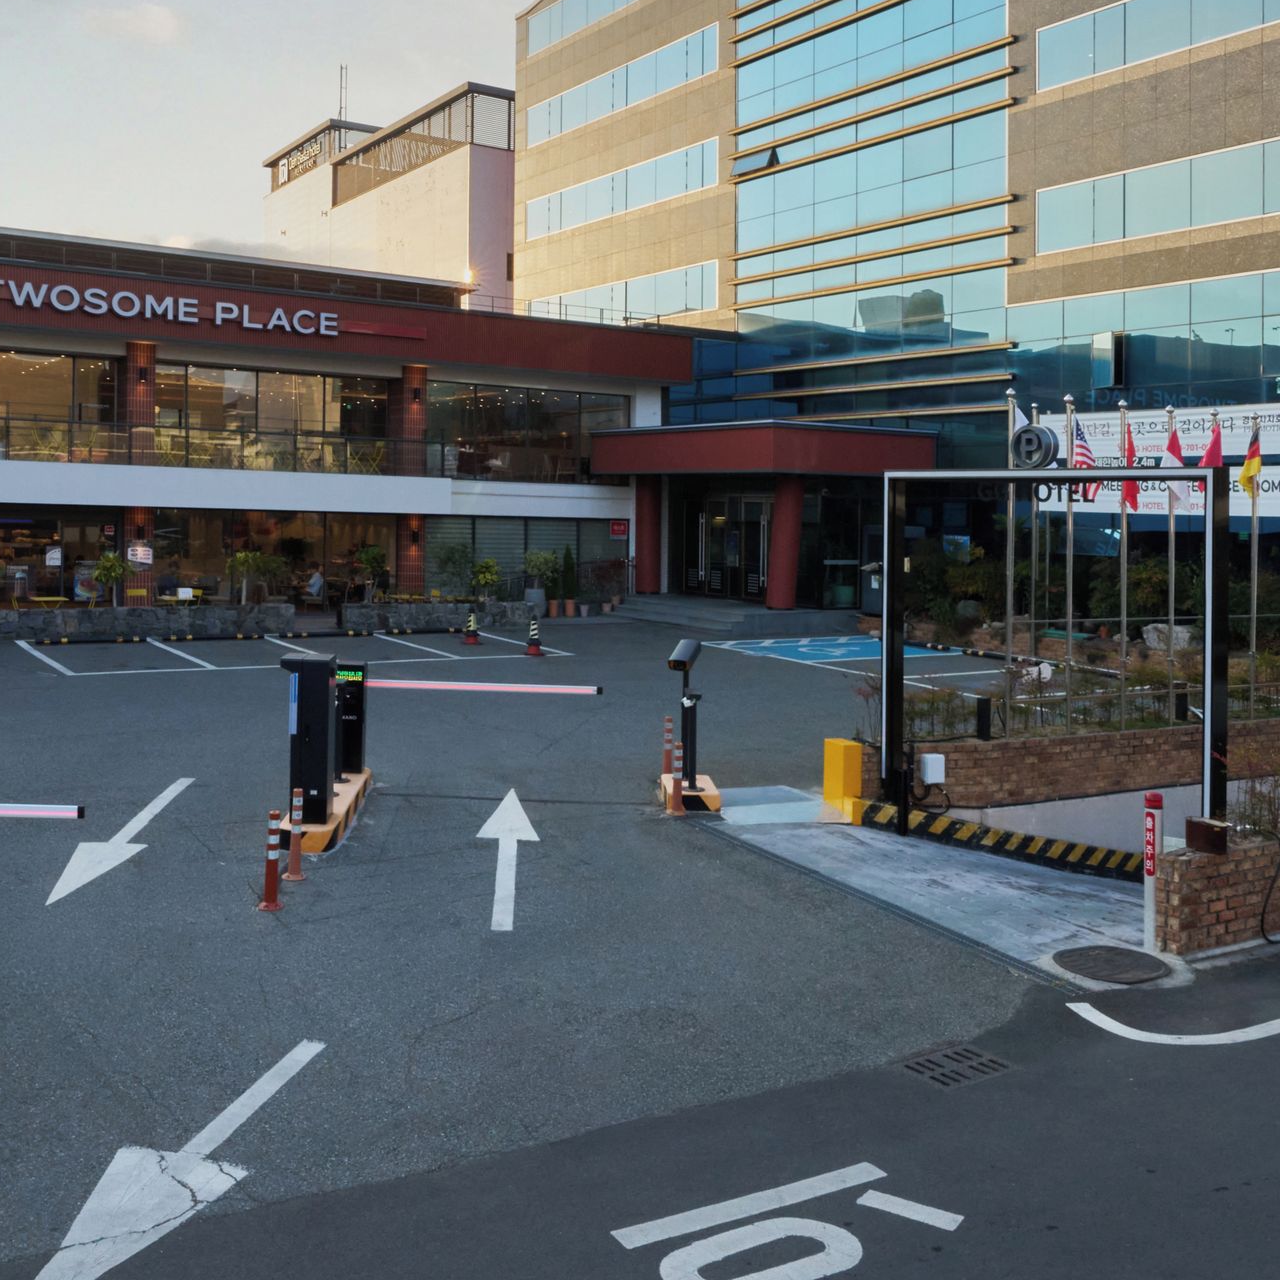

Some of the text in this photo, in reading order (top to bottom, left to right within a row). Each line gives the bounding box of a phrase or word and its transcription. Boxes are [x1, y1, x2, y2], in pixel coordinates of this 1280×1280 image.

[214, 302, 339, 337] PLACE
[1020, 433, 1039, 463] P
[1132, 456, 1155, 467] 2.4m
